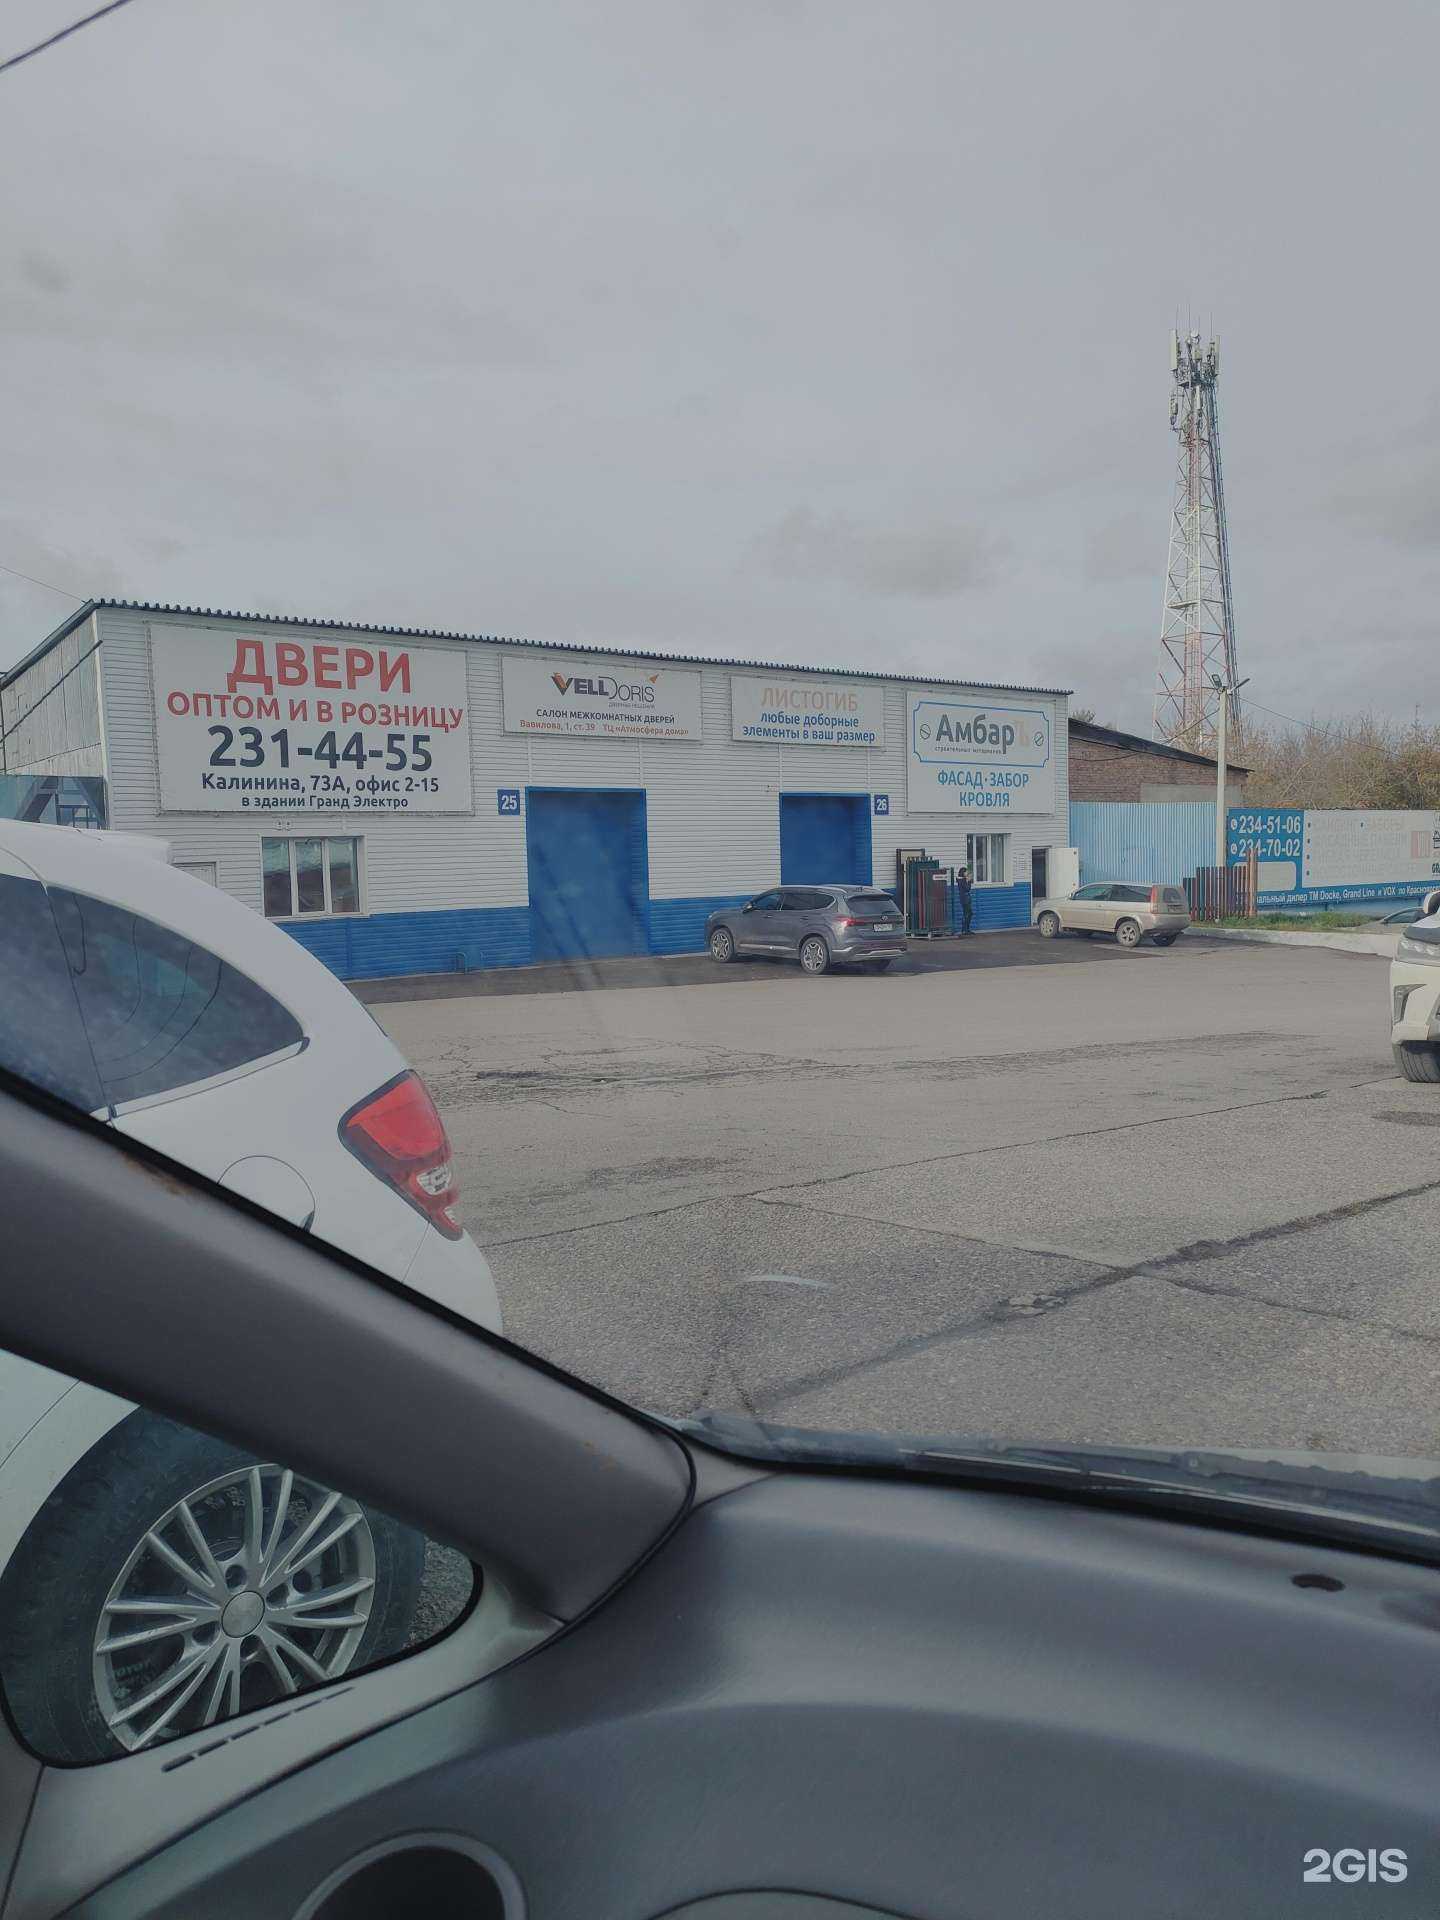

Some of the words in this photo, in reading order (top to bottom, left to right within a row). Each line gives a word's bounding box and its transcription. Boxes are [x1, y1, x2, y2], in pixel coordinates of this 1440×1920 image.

[226, 638, 411, 695] ДВЕРИ
[761, 687, 858, 712] ЛИСТОГИБ
[167, 691, 280, 721] ОПТОМ
[289, 699, 308, 722] И
[317, 700, 334, 723] В
[341, 702, 464, 733] РОЗНИЦУ
[536, 708, 568, 718] САЛОН
[569, 710, 642, 723] МЕЖКОМНАТНЫХ
[644, 714, 675, 725] ДВЕРЕЙ
[761, 711, 800, 725] любые
[803, 713, 859, 730] доборные
[742, 725, 800, 740] элементы
[802, 729, 810, 740] в
[812, 730, 834, 741] ваш
[836, 730, 875, 744] размер
[207, 724, 433, 772] 231-44-55
[202, 772, 306, 795] Калинина,
[310, 774, 351, 796] 73А,
[355, 776, 400, 795] офис
[404, 777, 439, 794] 2-15
[937, 769, 984, 789] ФАСАД
[990, 772, 1029, 788] ЗАБОР
[241, 796, 251, 807] в
[253, 796, 306, 809] здании
[309, 795, 350, 810] Гранд
[353, 796, 409, 810] Электро
[501, 795, 518, 810] 25
[876, 799, 887, 811] 26
[959, 791, 1010, 807] КРОВЛЯ
[1239, 815, 1301, 834] 234-51-06
[1342, 887, 1361, 900] Grand
[1362, 887, 1376, 897] Line
